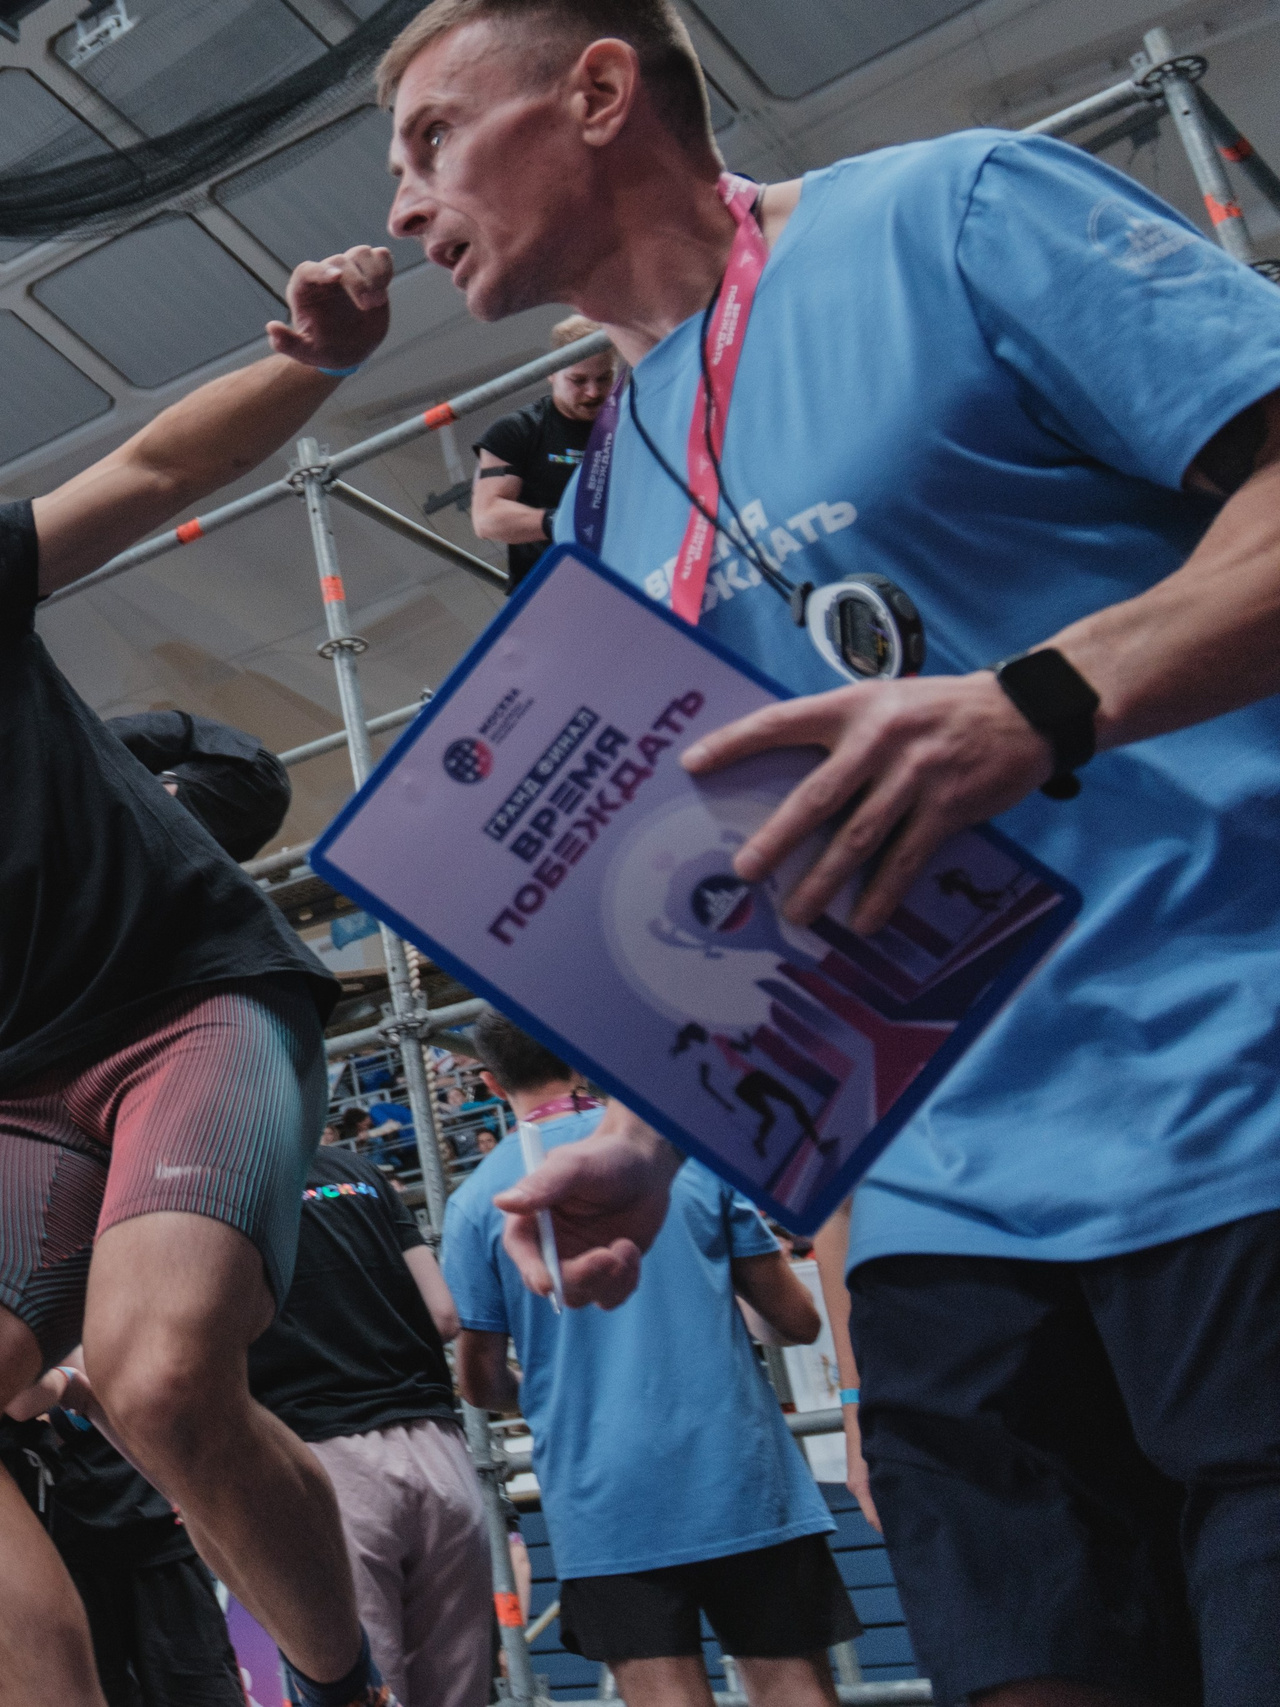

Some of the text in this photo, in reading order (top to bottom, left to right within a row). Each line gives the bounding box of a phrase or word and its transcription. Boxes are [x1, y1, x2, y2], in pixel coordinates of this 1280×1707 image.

[592, 432, 613, 509] ПОБЕЖДАТЬ
[487, 779, 542, 837] ГРАНД
[535, 710, 594, 776] ФИНАЛ
[488, 690, 705, 946] ПОБЕЖДАТЬ
[510, 724, 629, 863] ВРЕМЯ
